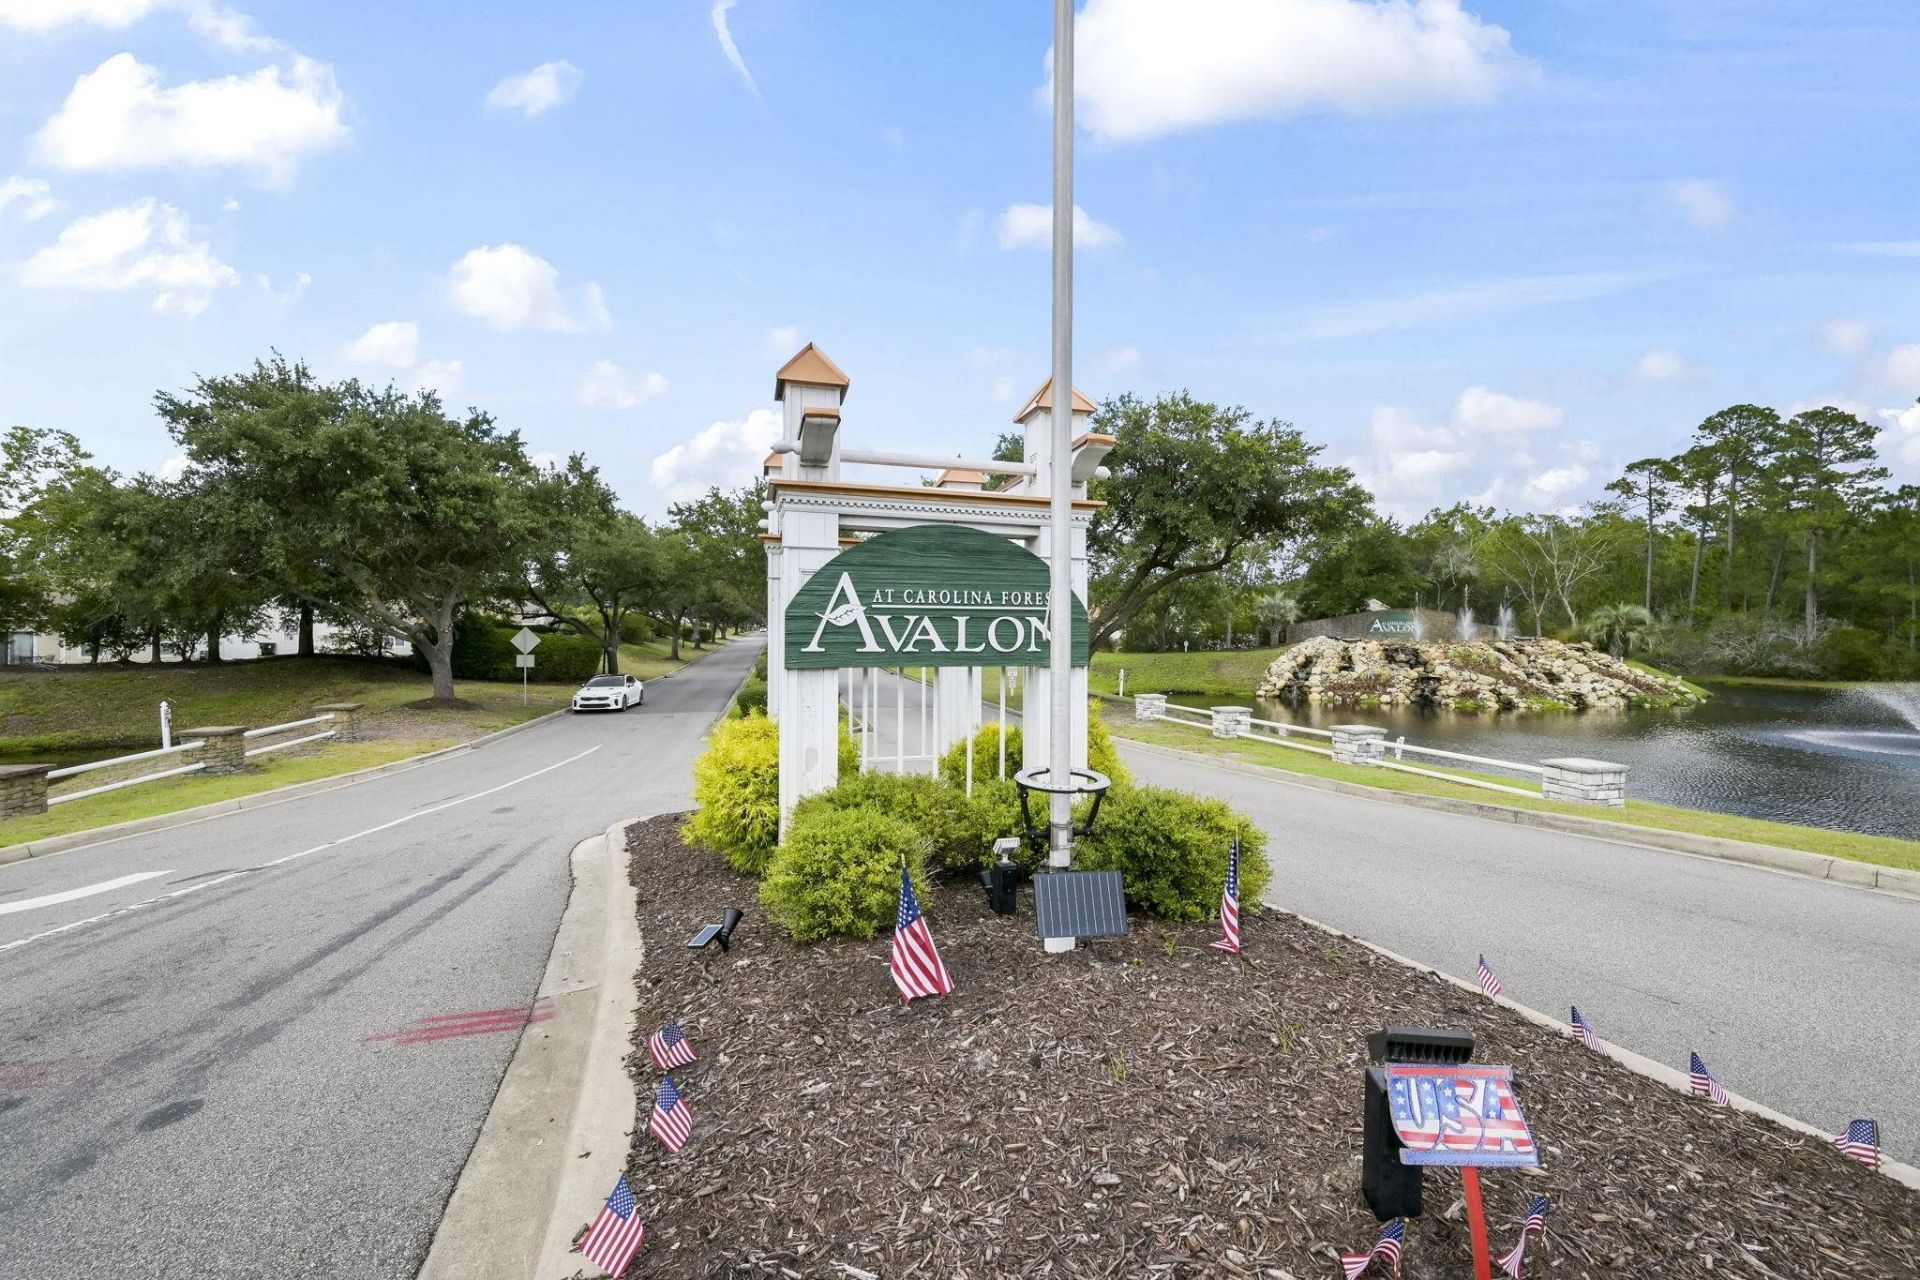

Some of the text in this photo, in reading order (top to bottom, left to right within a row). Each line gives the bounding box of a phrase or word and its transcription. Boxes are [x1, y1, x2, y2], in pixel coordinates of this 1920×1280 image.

[872, 589, 1051, 606] AT CAROLINA FORES
[1387, 1074, 1536, 1153] USA
